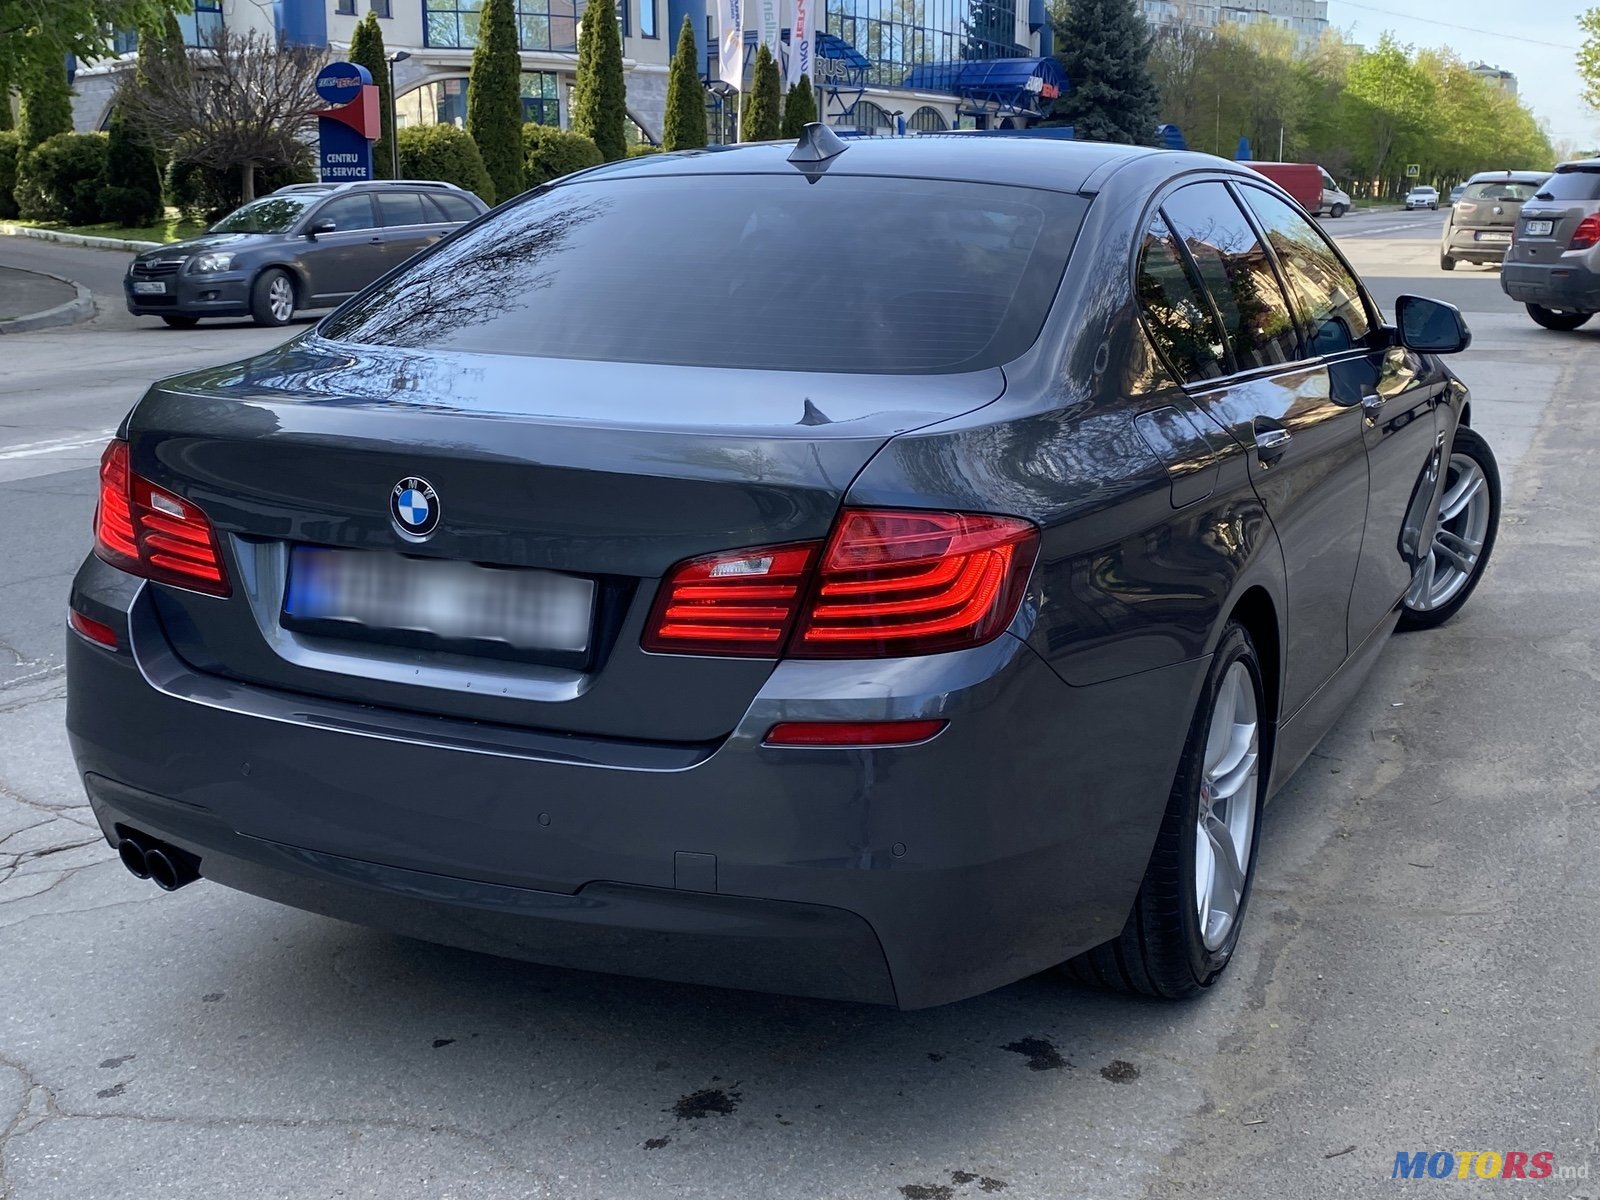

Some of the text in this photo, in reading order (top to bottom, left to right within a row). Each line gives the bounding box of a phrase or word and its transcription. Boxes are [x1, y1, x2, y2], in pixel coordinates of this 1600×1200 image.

[326, 153, 358, 163] CENTRU
[322, 167, 367, 177] DE SERVICE
[394, 479, 435, 500] BMW
